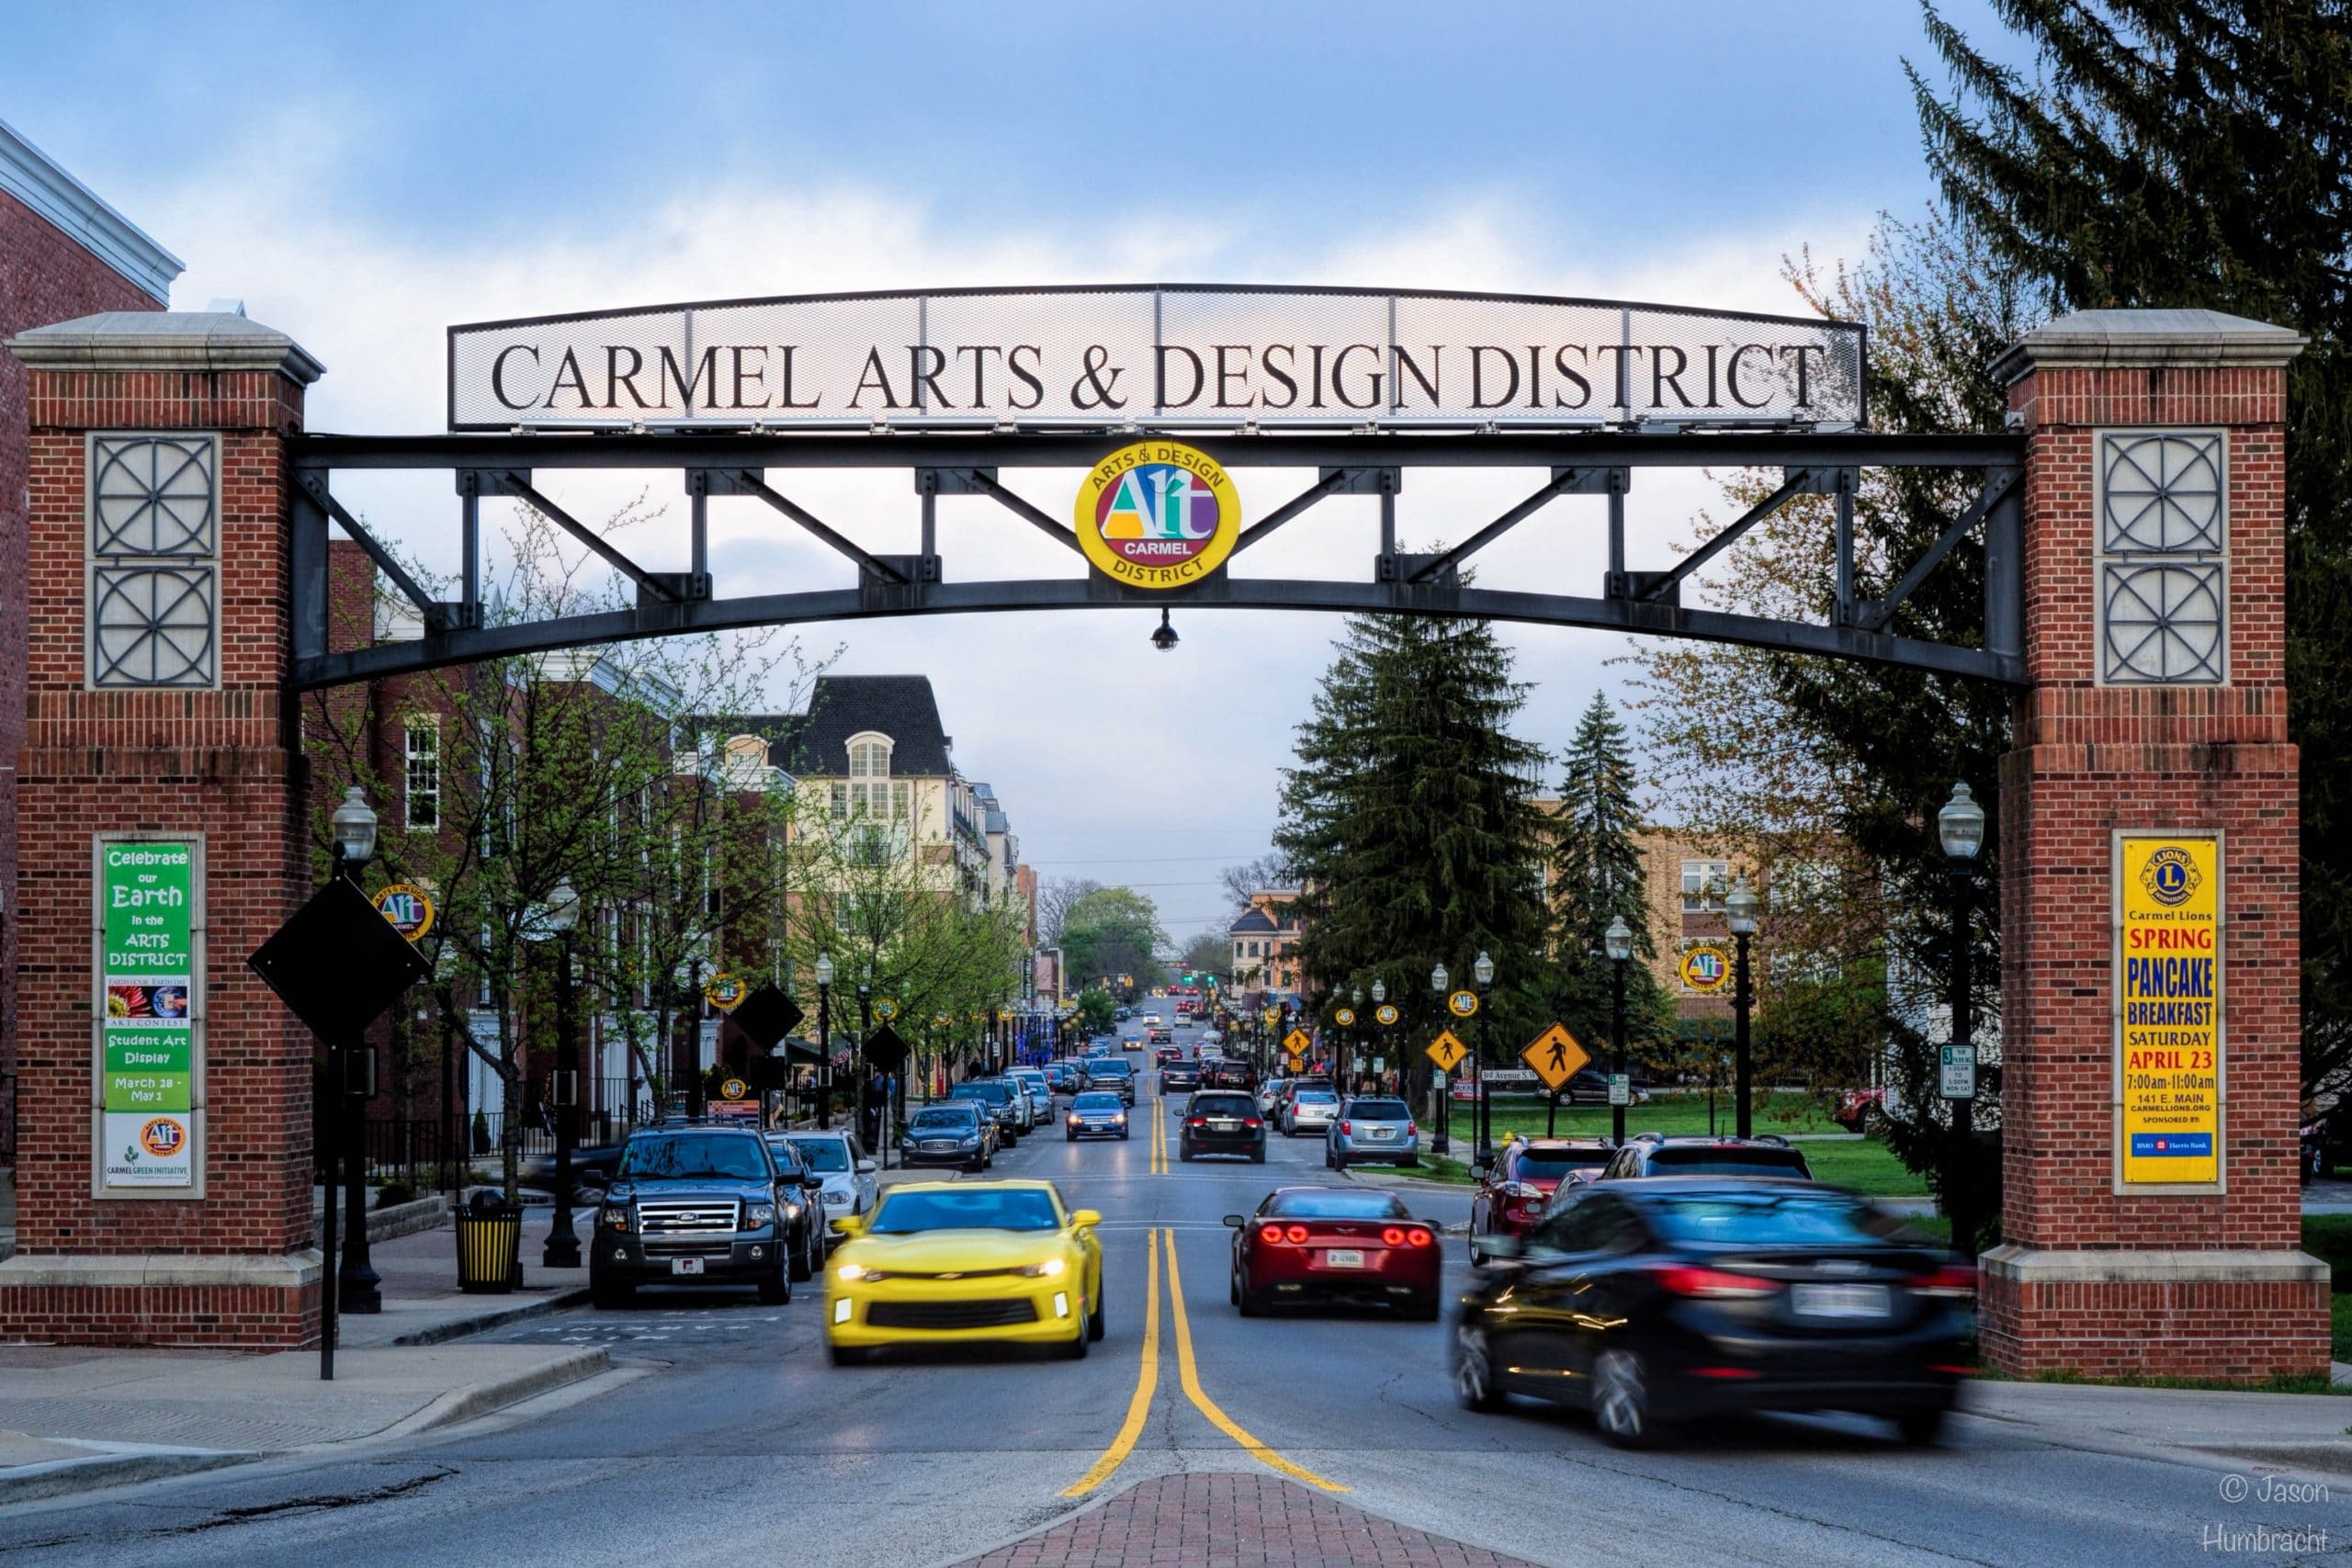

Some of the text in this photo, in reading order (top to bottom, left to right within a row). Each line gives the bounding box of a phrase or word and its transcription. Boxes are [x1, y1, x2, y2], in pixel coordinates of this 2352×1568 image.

[492, 344, 1826, 410] CARMEL ARTS & DESIGN DISTRICT
[1092, 447, 1225, 491] ARTS & DESIGN
[1101, 468, 1214, 539] Art
[1125, 542, 1193, 555] CARMEL
[1113, 558, 1204, 582] DISTRICT
[108, 851, 188, 866] Celebrate
[2156, 851, 2187, 863] LIONS
[138, 874, 158, 883] our
[2164, 865, 2180, 887] L
[112, 885, 183, 908] Earth
[2154, 891, 2189, 903] INTERNATIONAL
[131, 915, 164, 925] in the
[2129, 910, 2212, 920] Carmel Lions
[125, 933, 170, 949] ARTS
[2130, 928, 2211, 950] SPRING
[109, 953, 187, 966] DISTRICT
[1688, 954, 1723, 976] Art
[2128, 957, 2212, 998] PANCAKE
[2128, 1001, 2212, 1026] BREAKFAST
[108, 1034, 187, 1047] Student Art
[2129, 1032, 2211, 1046] SATURDAY
[125, 1052, 170, 1064] Display
[1943, 1049, 1951, 1062] 3
[2129, 1051, 2212, 1069] APRIL 23
[1495, 1071, 1521, 1079] Avenue
[115, 1077, 155, 1089] March
[159, 1077, 174, 1089] 28
[131, 1090, 163, 1101] May 1
[2138, 1094, 2204, 1103] 141 E. MAIN
[148, 1124, 179, 1145] Art
